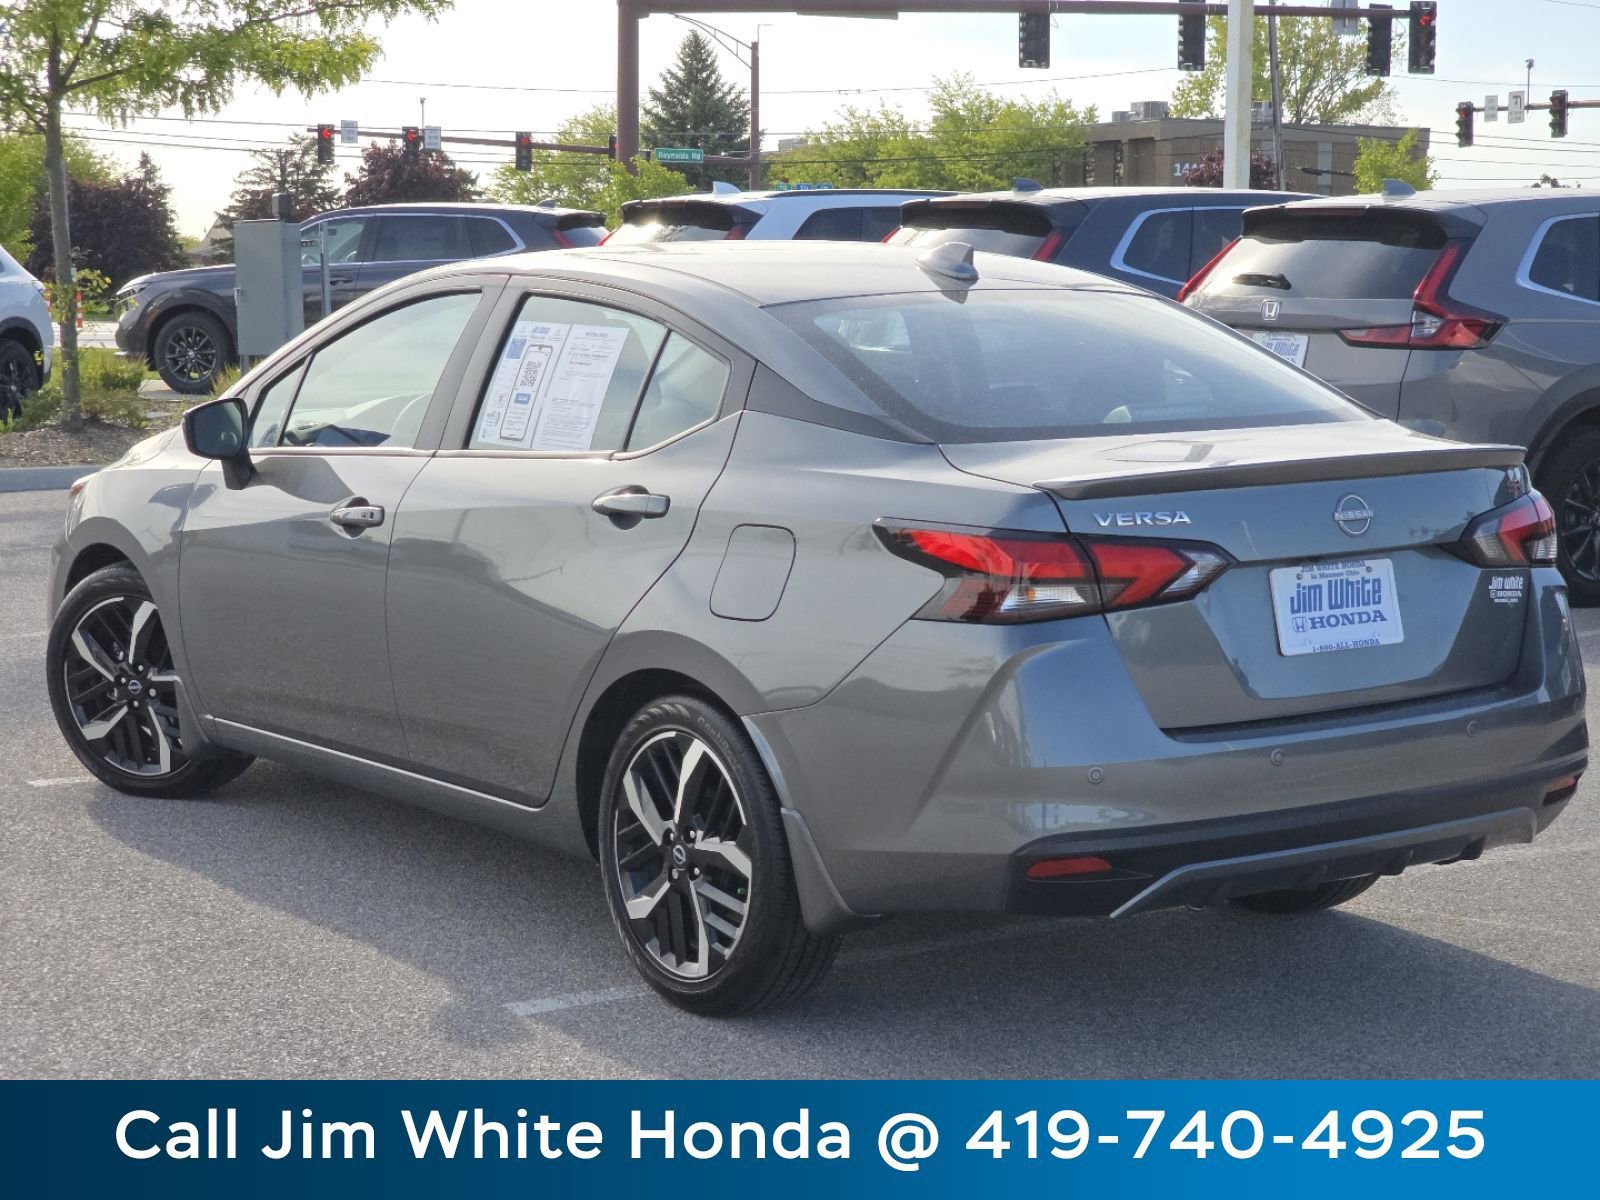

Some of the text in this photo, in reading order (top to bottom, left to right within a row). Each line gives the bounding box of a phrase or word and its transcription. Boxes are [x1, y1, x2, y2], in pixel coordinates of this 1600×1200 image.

[658, 151, 701, 160] Reynolds Rd
[1093, 510, 1192, 527] VERSA
[1290, 576, 1382, 614] Jim White
[1497, 590, 1522, 598] HONDA
[1309, 610, 1388, 629] HONDA
